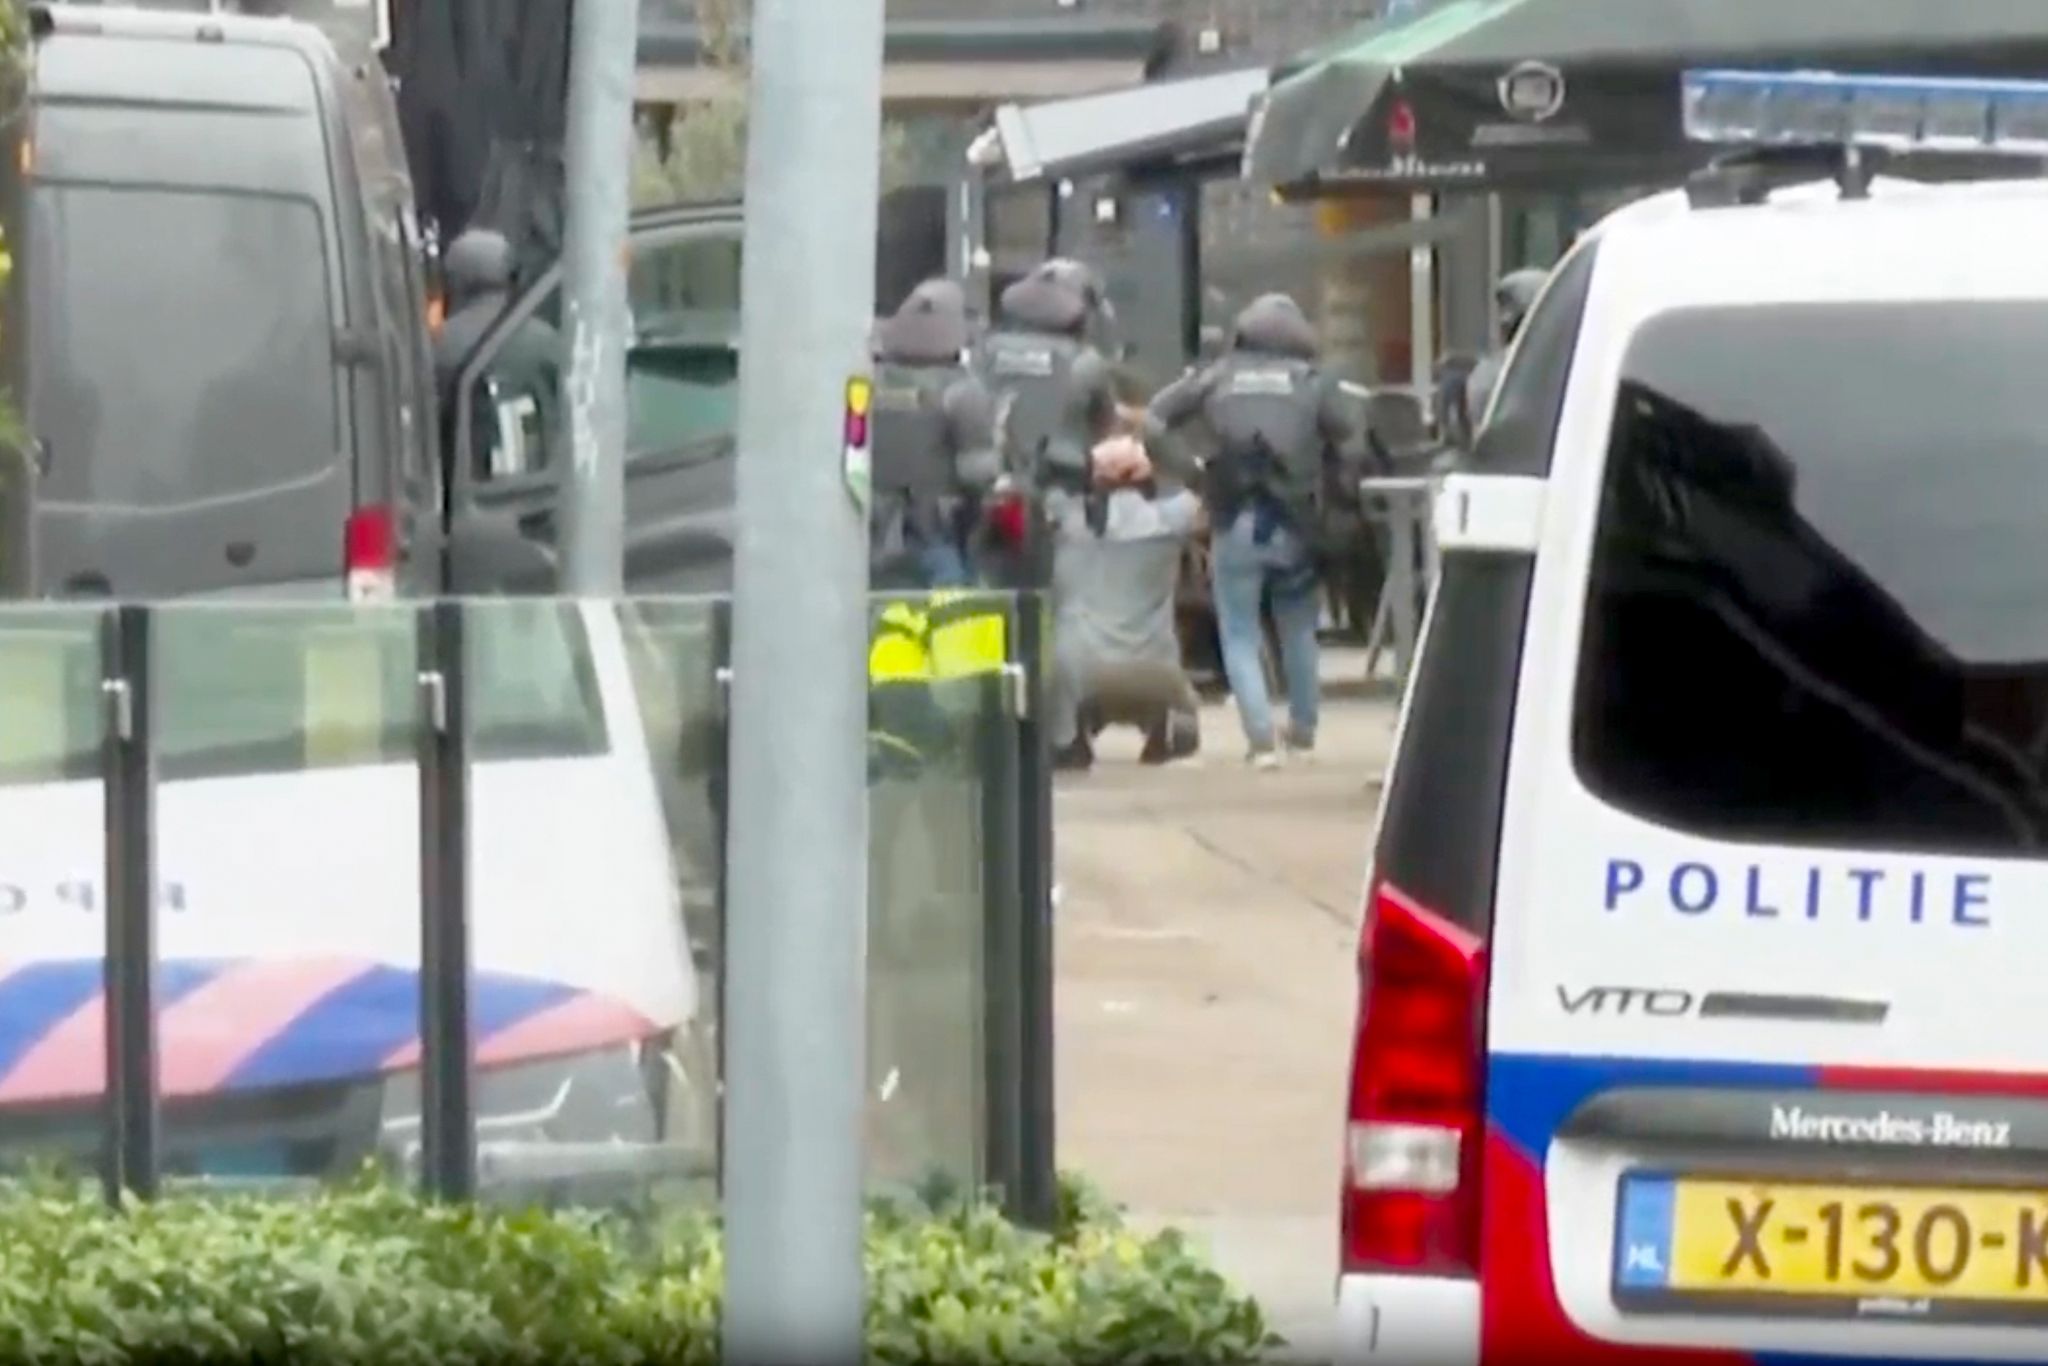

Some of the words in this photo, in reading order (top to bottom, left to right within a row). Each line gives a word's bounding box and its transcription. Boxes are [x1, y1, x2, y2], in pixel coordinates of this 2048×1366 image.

[1604, 859, 1991, 926] POLITIE
[1556, 984, 1693, 1016] VITO
[1770, 1107, 2010, 1147] Mercedes-Benz
[1627, 1245, 1663, 1270] NL
